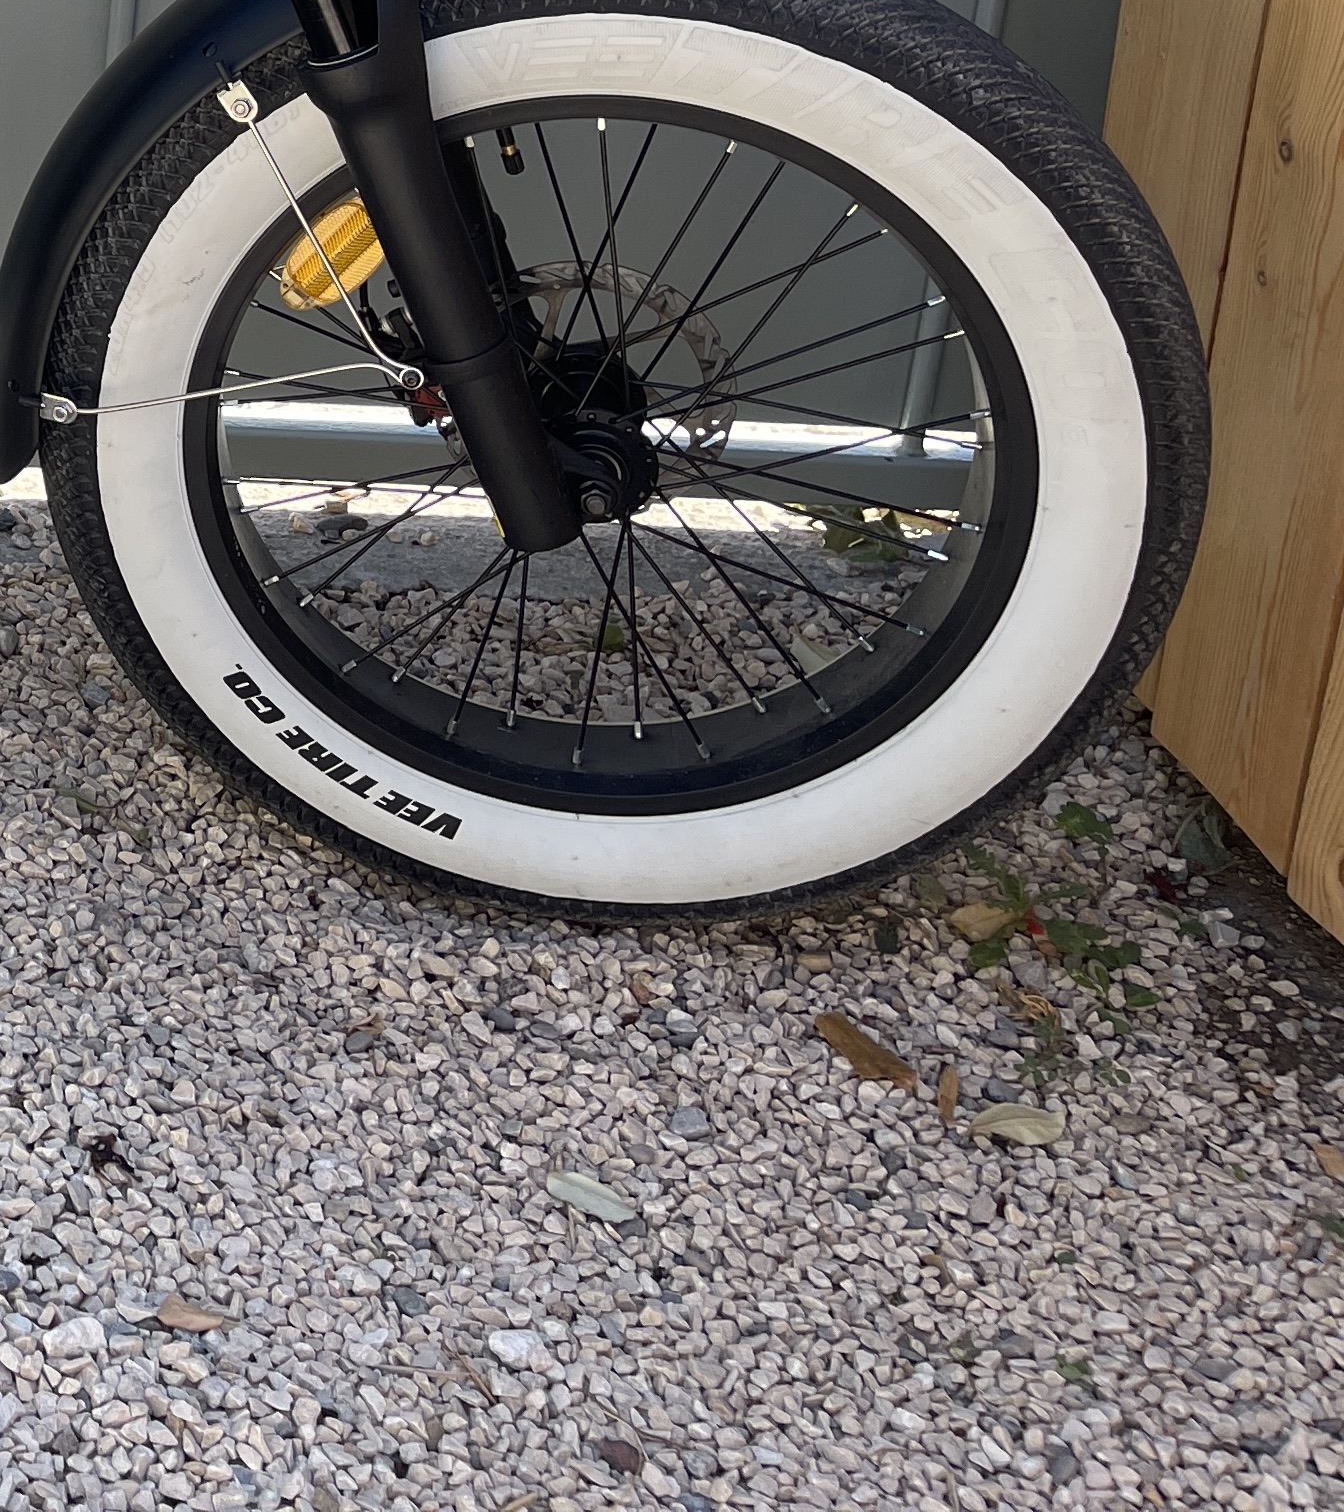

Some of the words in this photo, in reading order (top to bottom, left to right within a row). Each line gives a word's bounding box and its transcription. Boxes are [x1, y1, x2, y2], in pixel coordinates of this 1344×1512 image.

[457, 20, 684, 90] VEE
[222, 663, 286, 725] CO.
[275, 725, 379, 800] TIRE
[373, 789, 463, 840] VEE
